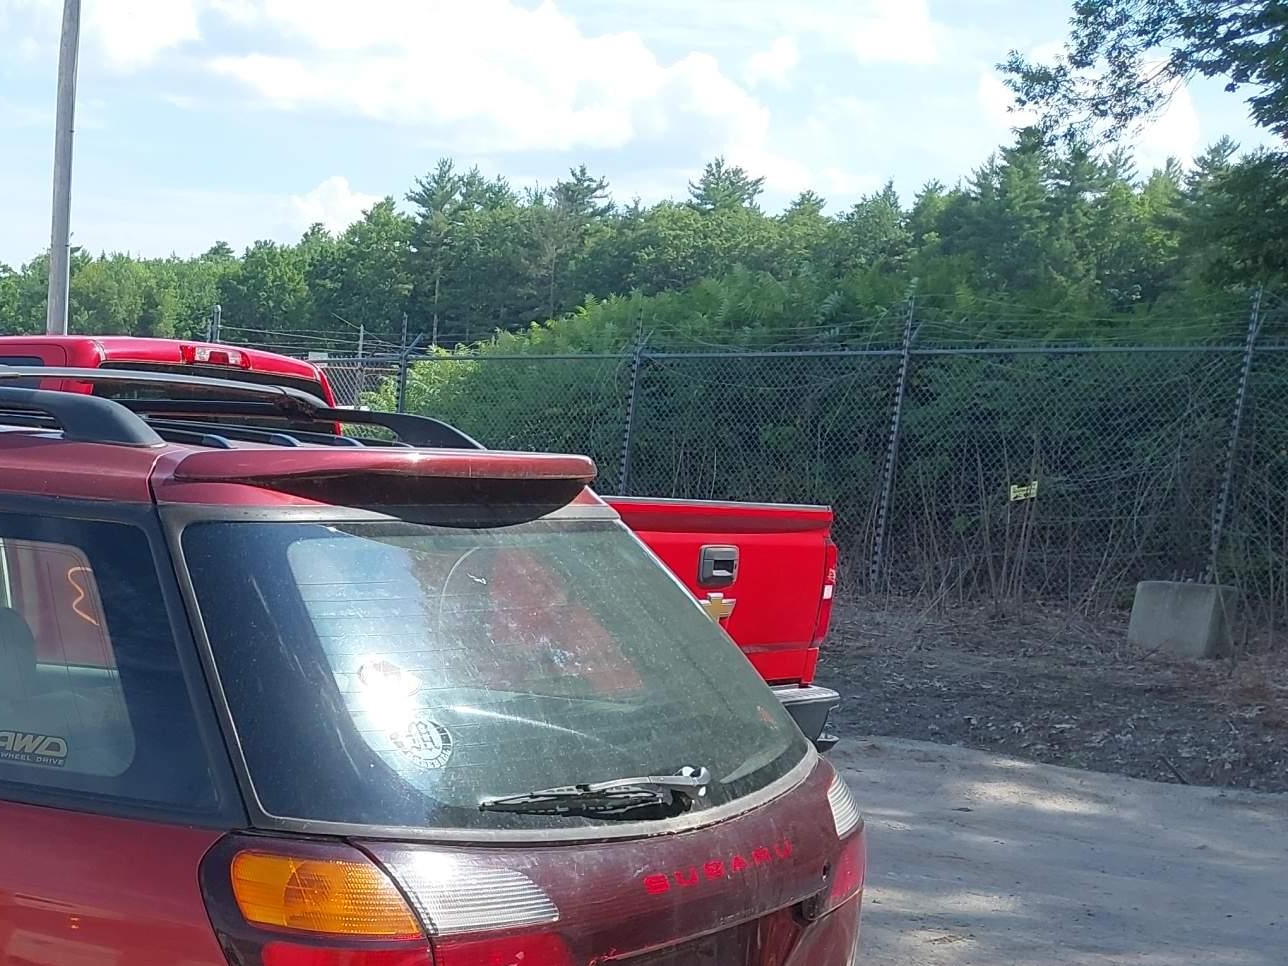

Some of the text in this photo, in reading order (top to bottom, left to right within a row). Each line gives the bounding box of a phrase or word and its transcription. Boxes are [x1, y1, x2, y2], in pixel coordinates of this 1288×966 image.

[0, 751, 33, 761] WHEEL
[35, 756, 65, 766] DRIVE
[643, 838, 793, 894] SUBARU
